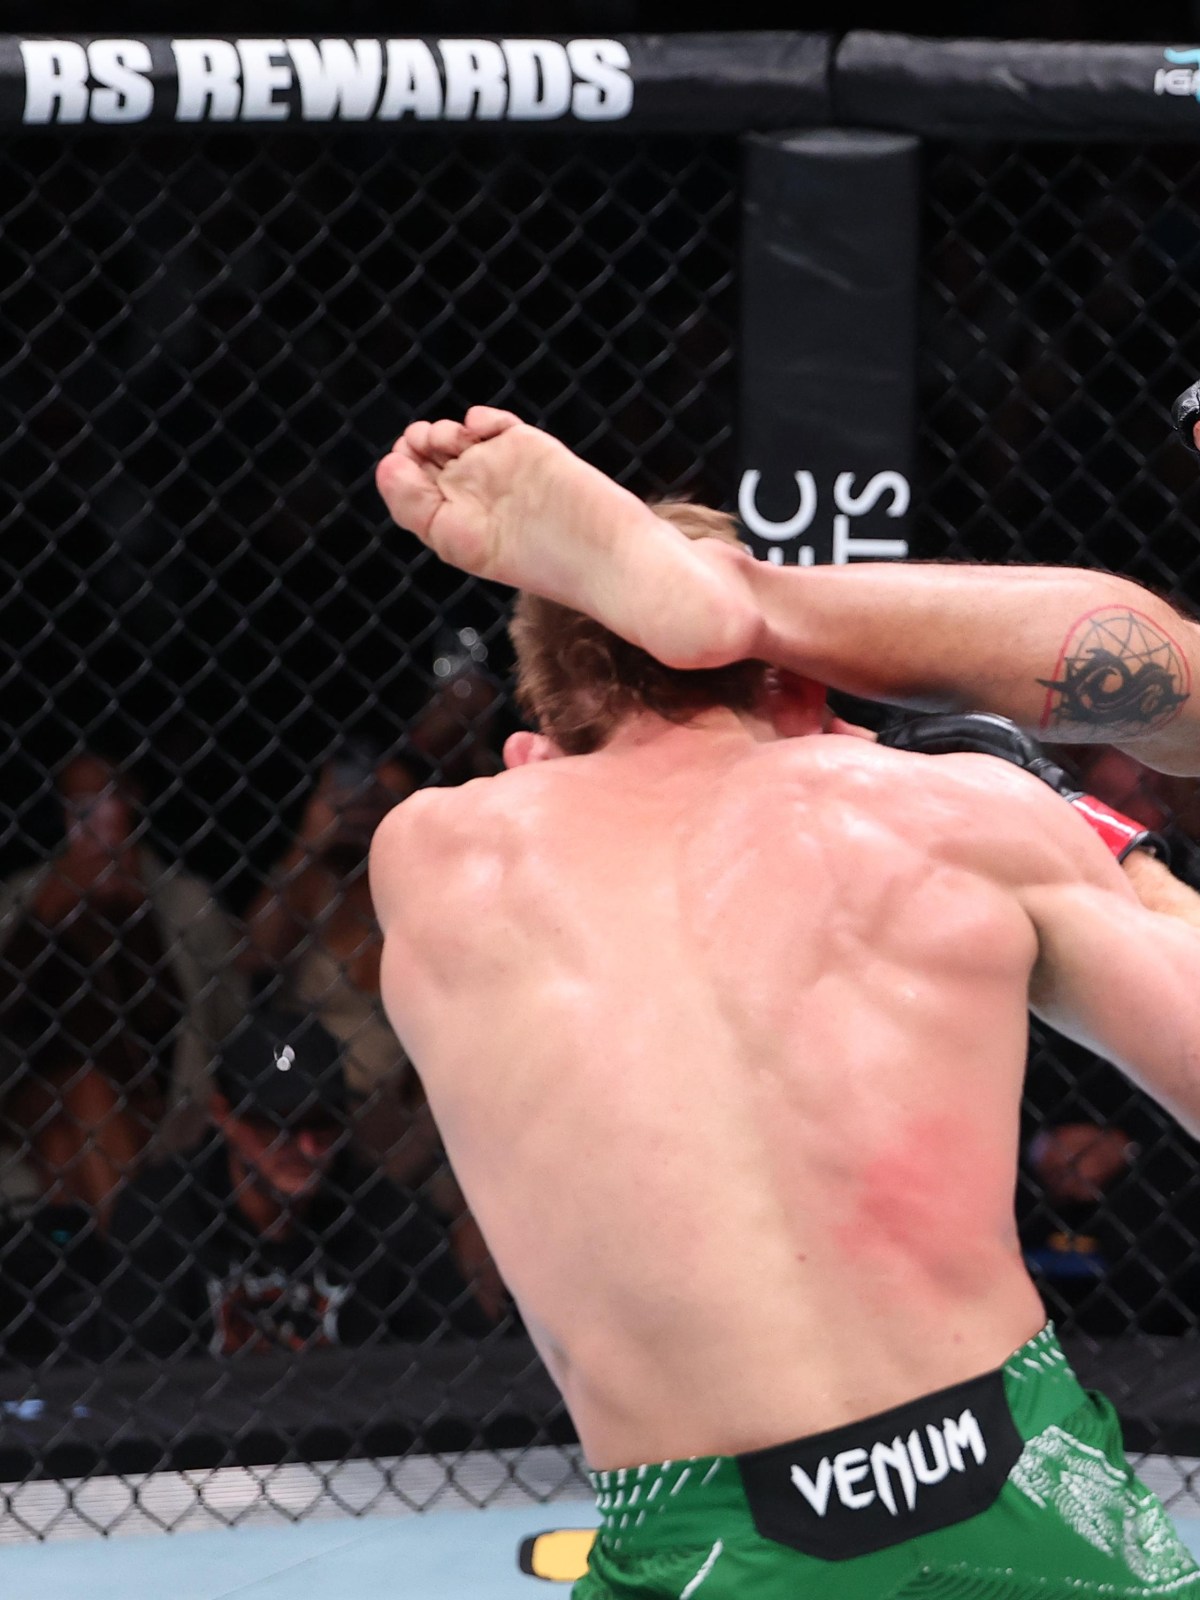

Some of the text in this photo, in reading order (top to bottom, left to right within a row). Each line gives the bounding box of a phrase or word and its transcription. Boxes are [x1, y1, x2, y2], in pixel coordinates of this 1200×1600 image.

[19, 38, 634, 125] RS REWARDS
[791, 1408, 987, 1517] VENUM
